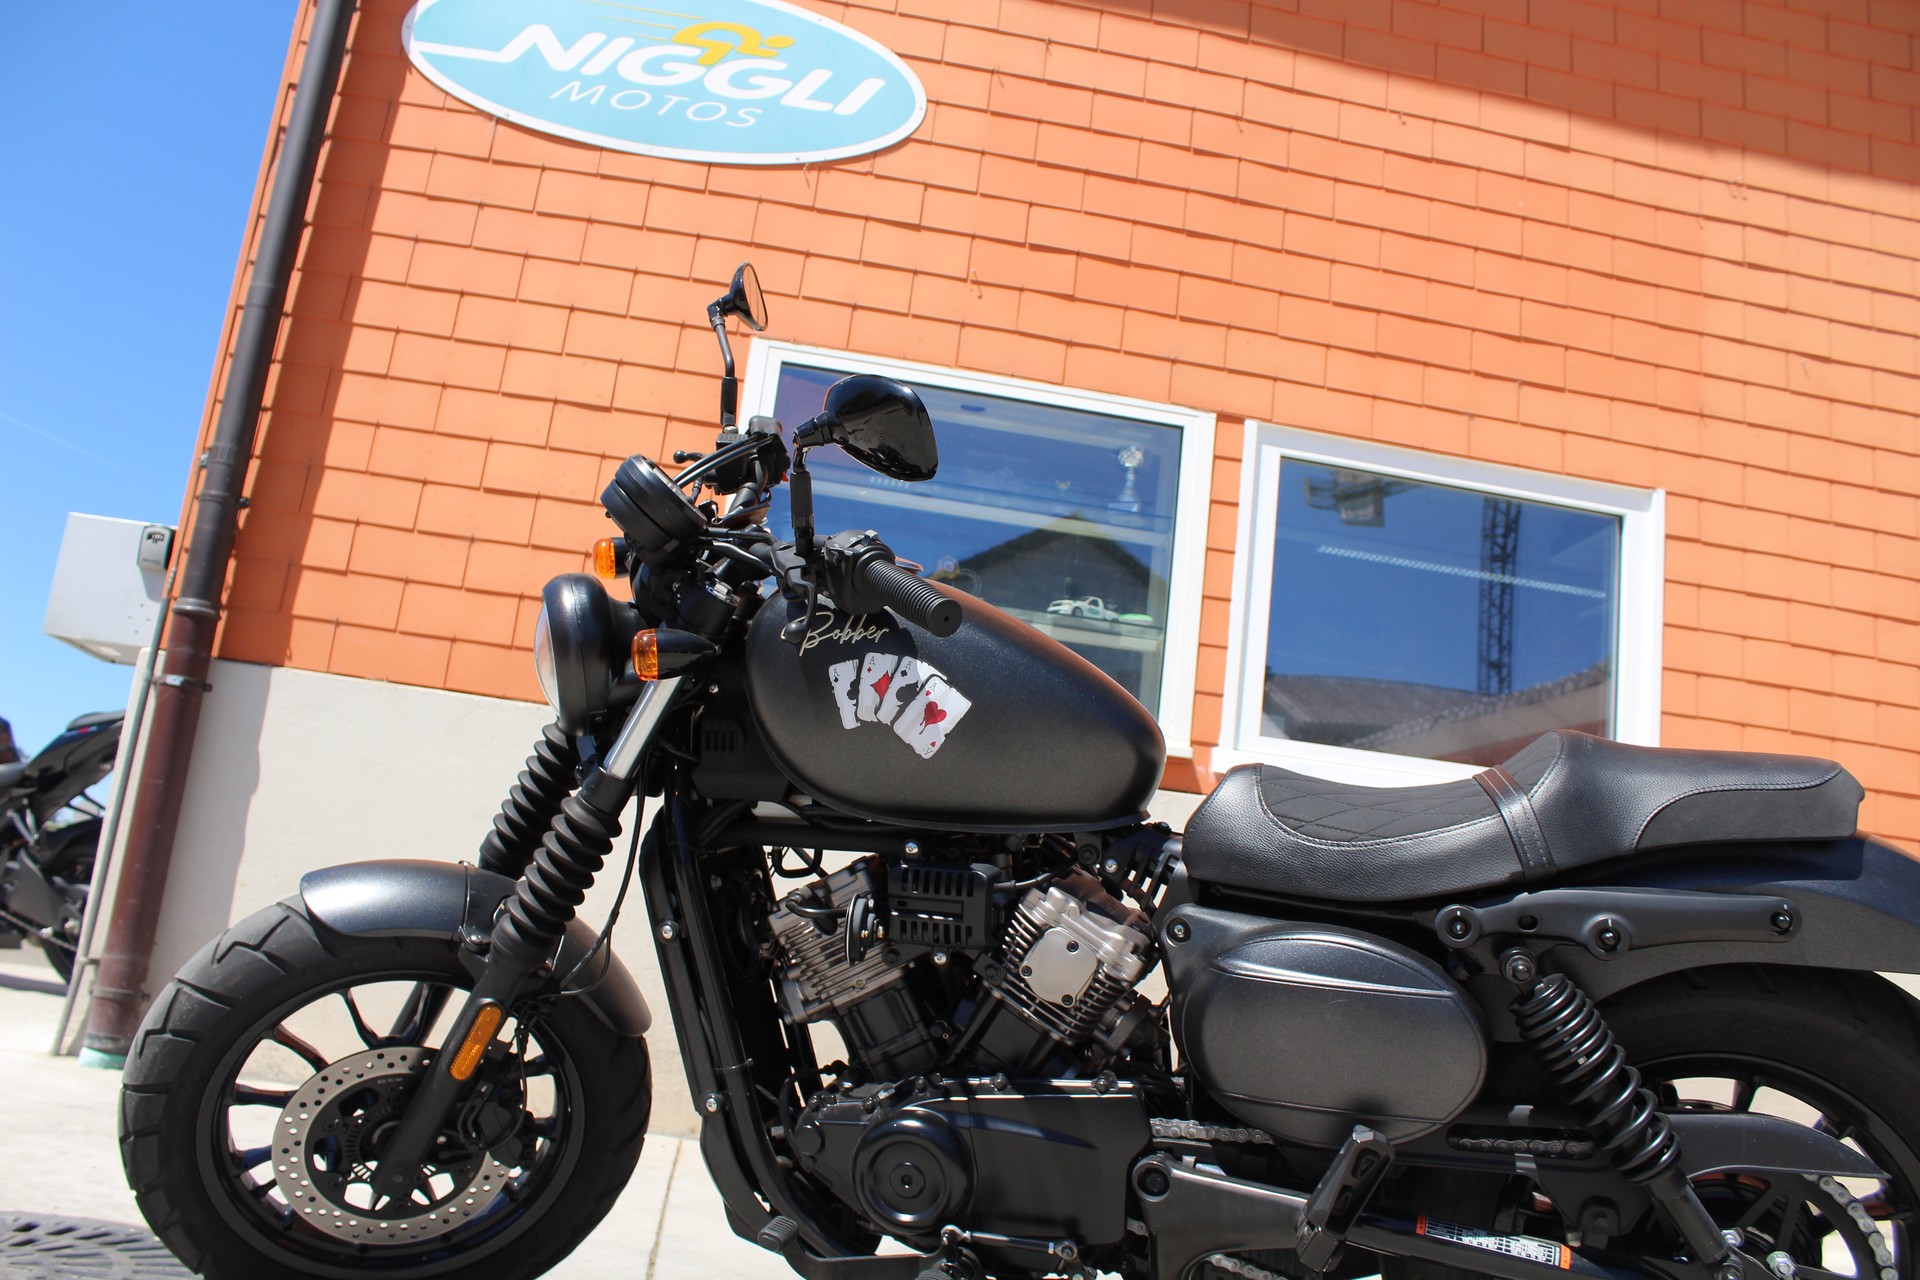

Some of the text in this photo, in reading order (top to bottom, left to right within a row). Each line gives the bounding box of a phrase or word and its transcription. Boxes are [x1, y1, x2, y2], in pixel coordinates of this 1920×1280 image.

[492, 23, 886, 116] NIGGLI
[549, 80, 764, 128] MOTOS
[781, 611, 890, 657] Bobber
